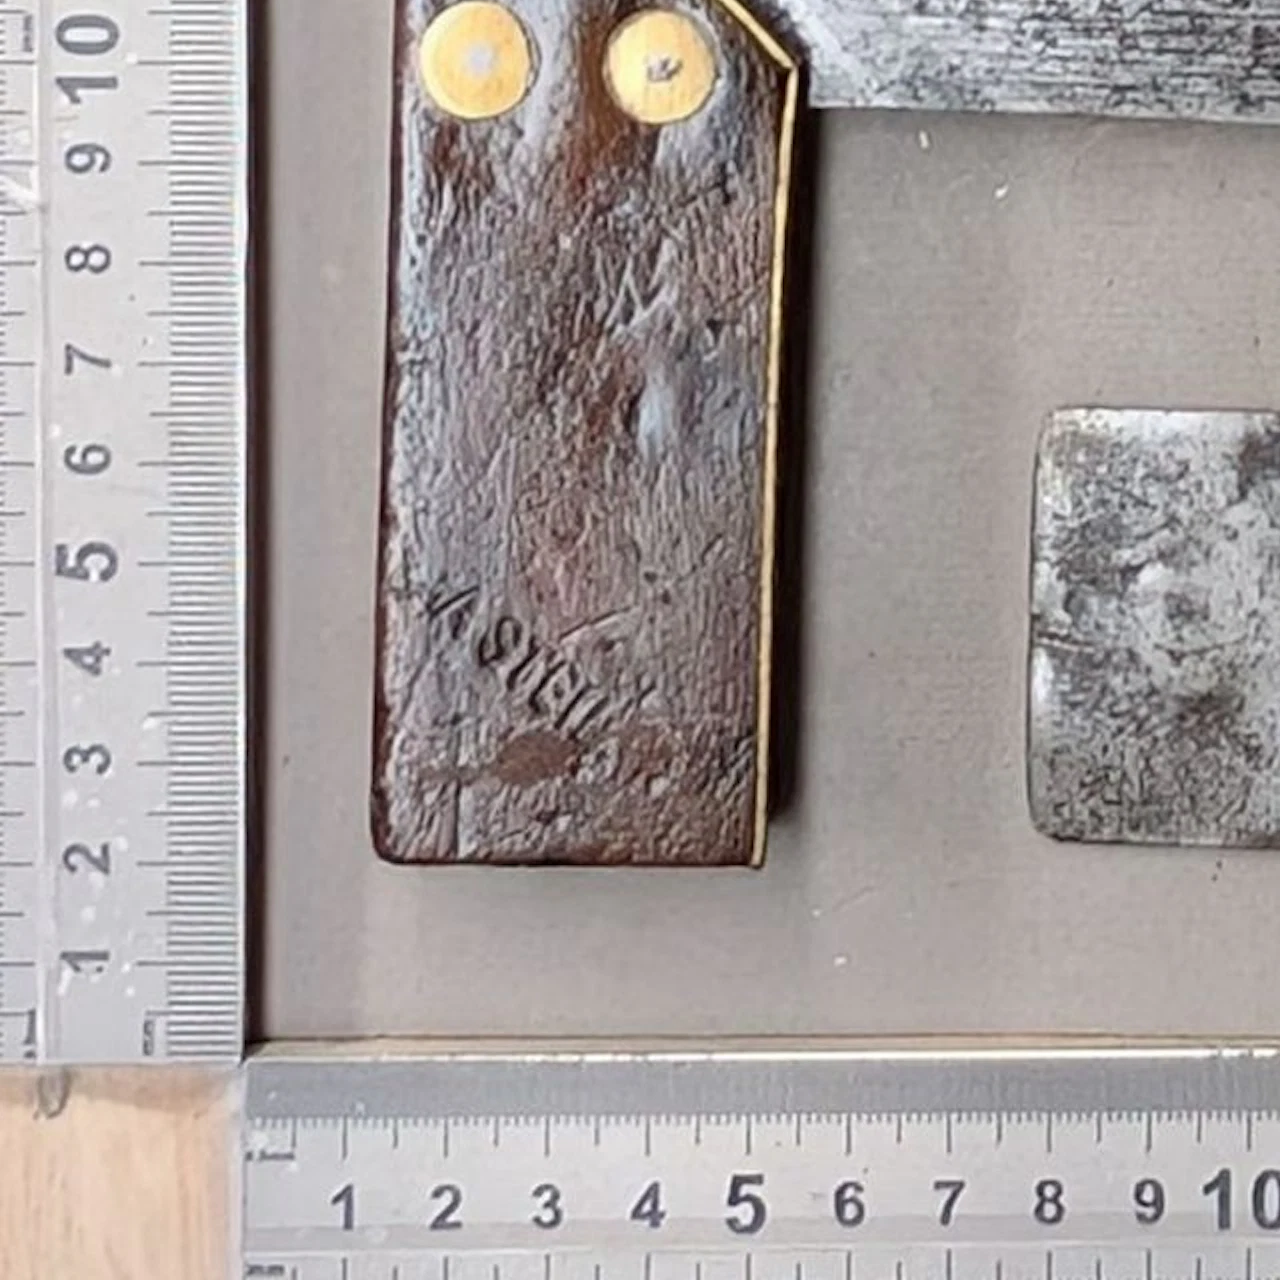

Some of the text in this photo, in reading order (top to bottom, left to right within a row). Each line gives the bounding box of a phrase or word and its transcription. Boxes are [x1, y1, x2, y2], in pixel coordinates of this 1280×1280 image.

[54, 13, 120, 106] 10
[62, 142, 113, 175] 9
[62, 243, 113, 276] 8
[62, 342, 113, 377] 7
[62, 442, 113, 476] 6
[54, 541, 120, 584] 5
[62, 640, 113, 678] 4
[62, 743, 113, 776] 3
[62, 842, 113, 877] 2
[62, 949, 113, 974] 1
[330, 1183, 355, 1232] 1
[428, 1183, 464, 1232] 2
[531, 1182, 564, 1231] 3
[629, 1180, 667, 1230] 4
[724, 1172, 767, 1236] 5
[833, 1180, 866, 1229] 6
[932, 1179, 967, 1228] 7
[1032, 1178, 1067, 1227] 8
[1132, 1177, 1166, 1228] 9
